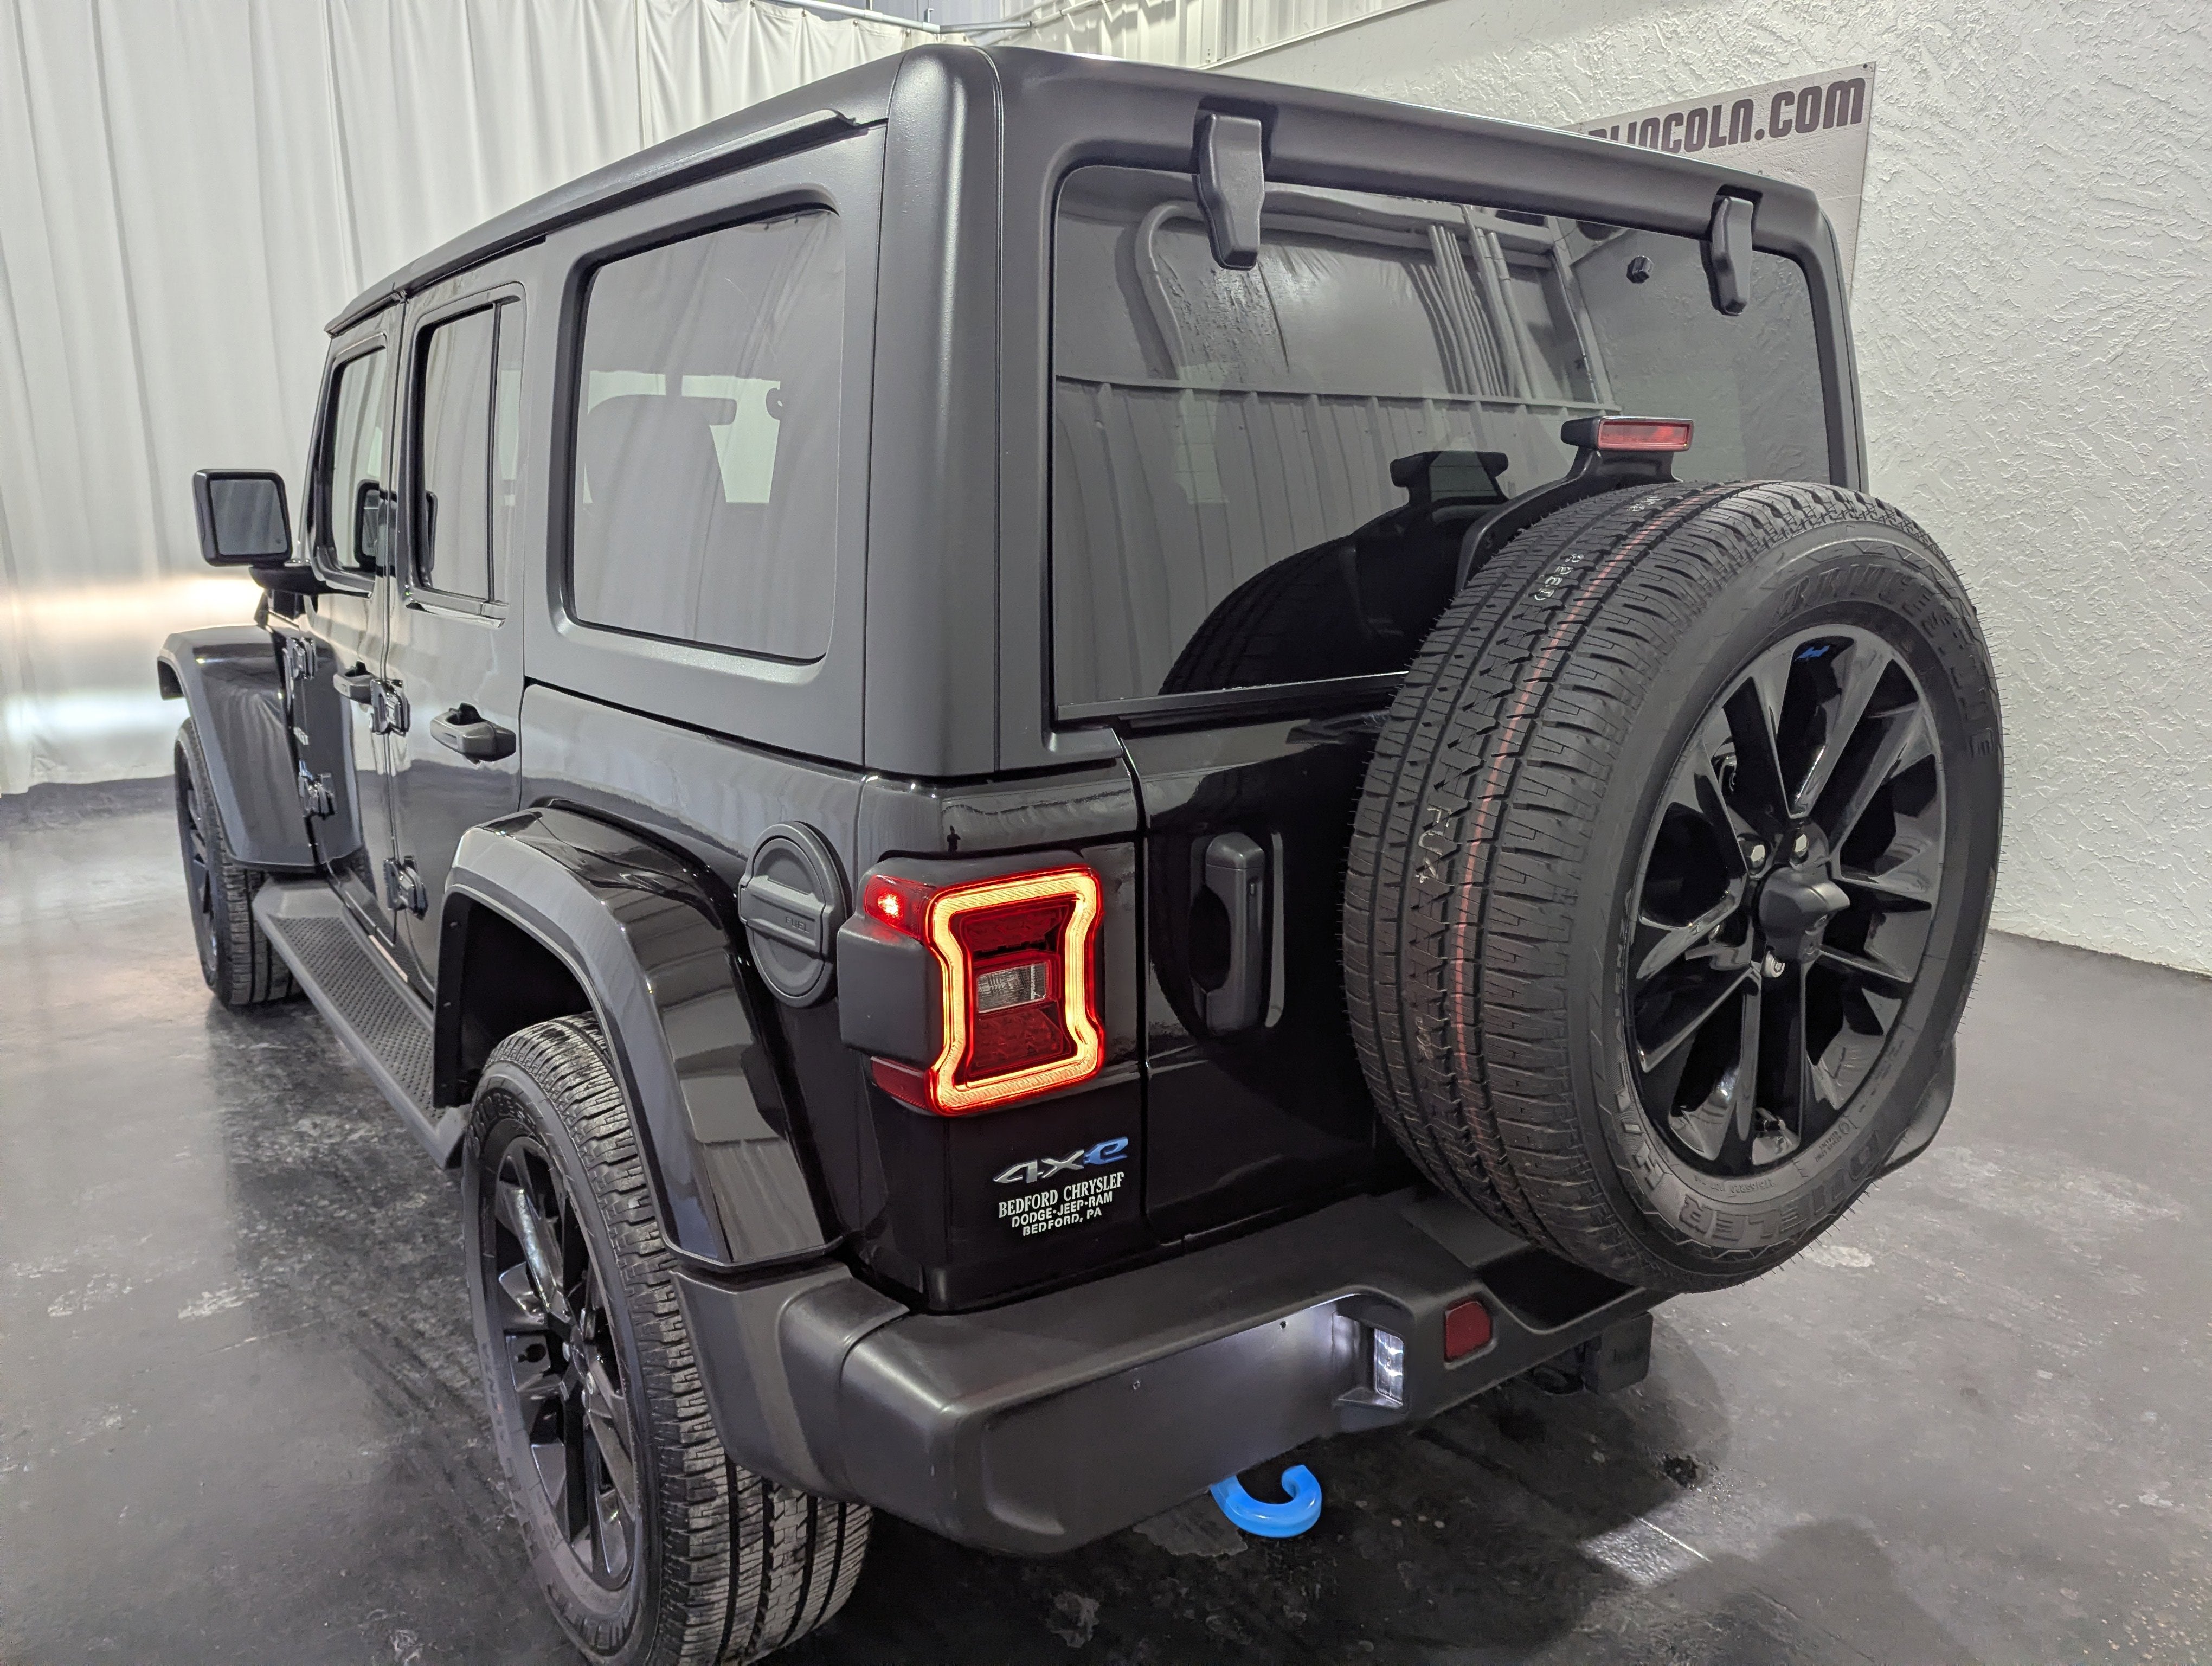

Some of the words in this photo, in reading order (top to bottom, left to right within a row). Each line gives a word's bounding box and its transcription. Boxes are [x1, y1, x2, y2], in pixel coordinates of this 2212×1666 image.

[785, 916, 811, 934] FUEL
[999, 1189, 1058, 1218] BEDFORD
[1023, 1213, 1083, 1236] BEDFORD,
[1086, 1207, 1102, 1220] PA
